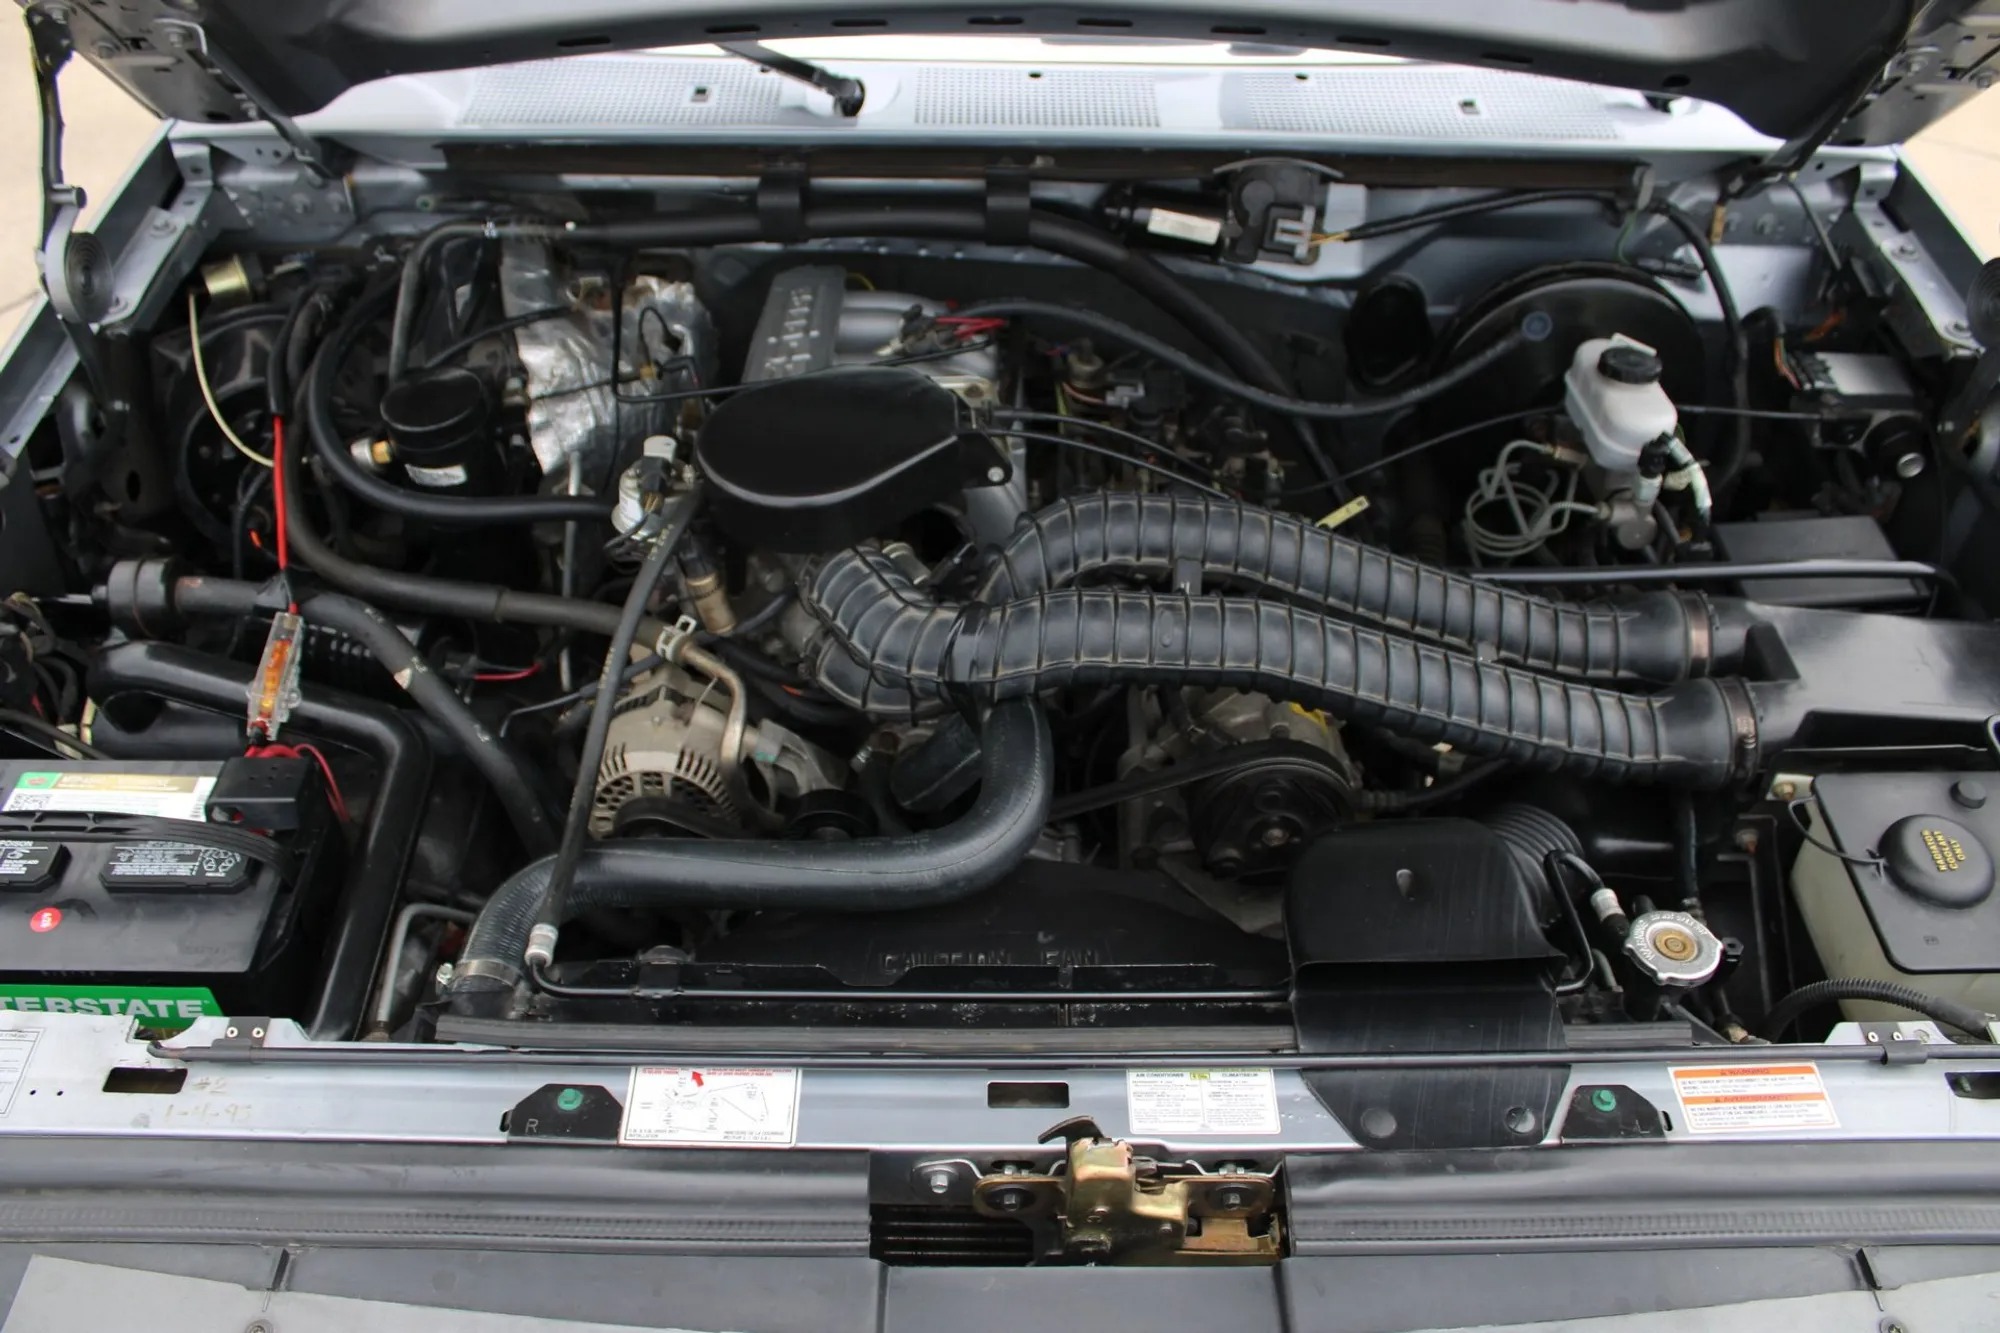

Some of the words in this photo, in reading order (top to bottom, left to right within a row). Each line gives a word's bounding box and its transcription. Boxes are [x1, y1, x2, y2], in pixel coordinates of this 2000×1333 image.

[1933, 830, 1959, 871] COOLANT
[1950, 838, 1966, 862] ONLY
[525, 1118, 539, 1133] R
